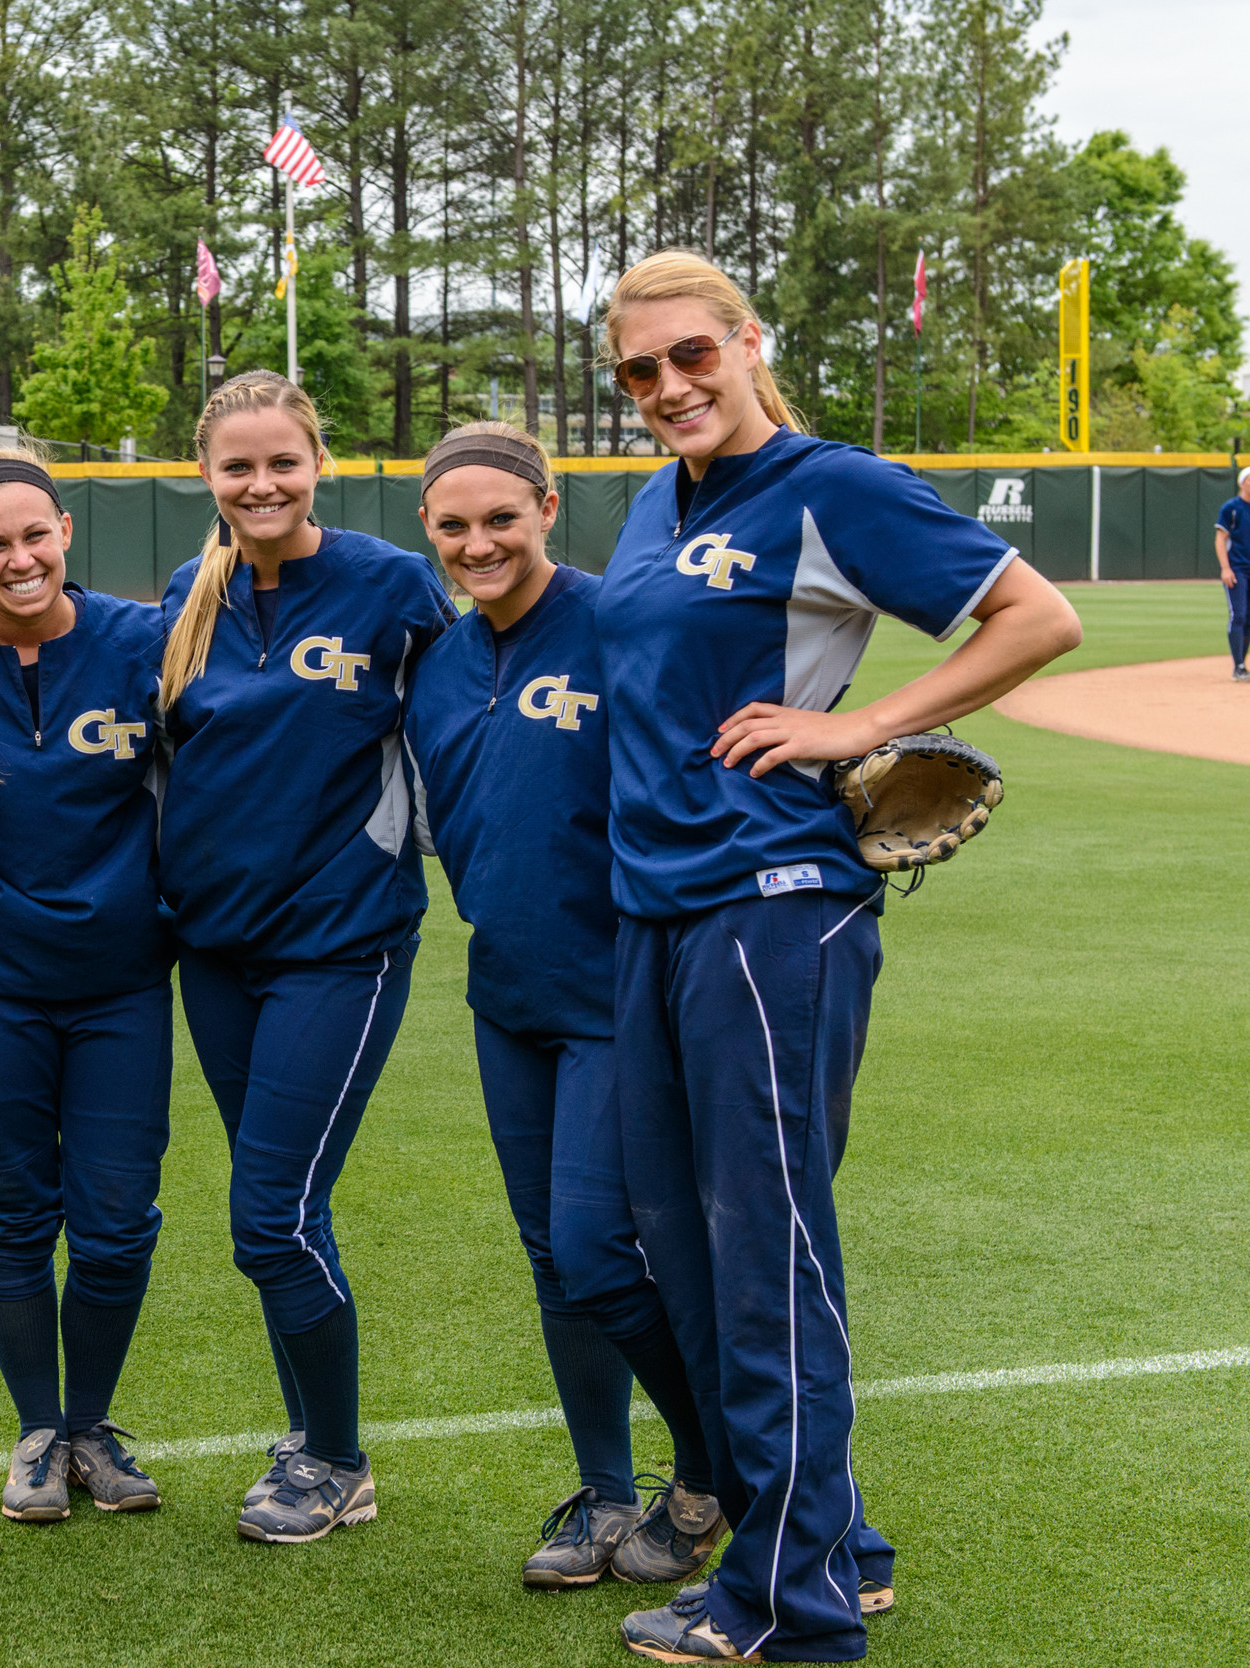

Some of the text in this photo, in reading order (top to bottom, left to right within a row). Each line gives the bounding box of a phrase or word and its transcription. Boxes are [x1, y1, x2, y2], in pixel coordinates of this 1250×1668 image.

[1068, 359, 1079, 440] 190
[988, 478, 1025, 505] R
[676, 532, 757, 591] GT
[290, 635, 371, 692] GT
[518, 674, 600, 731] GT
[67, 708, 146, 760] GT
